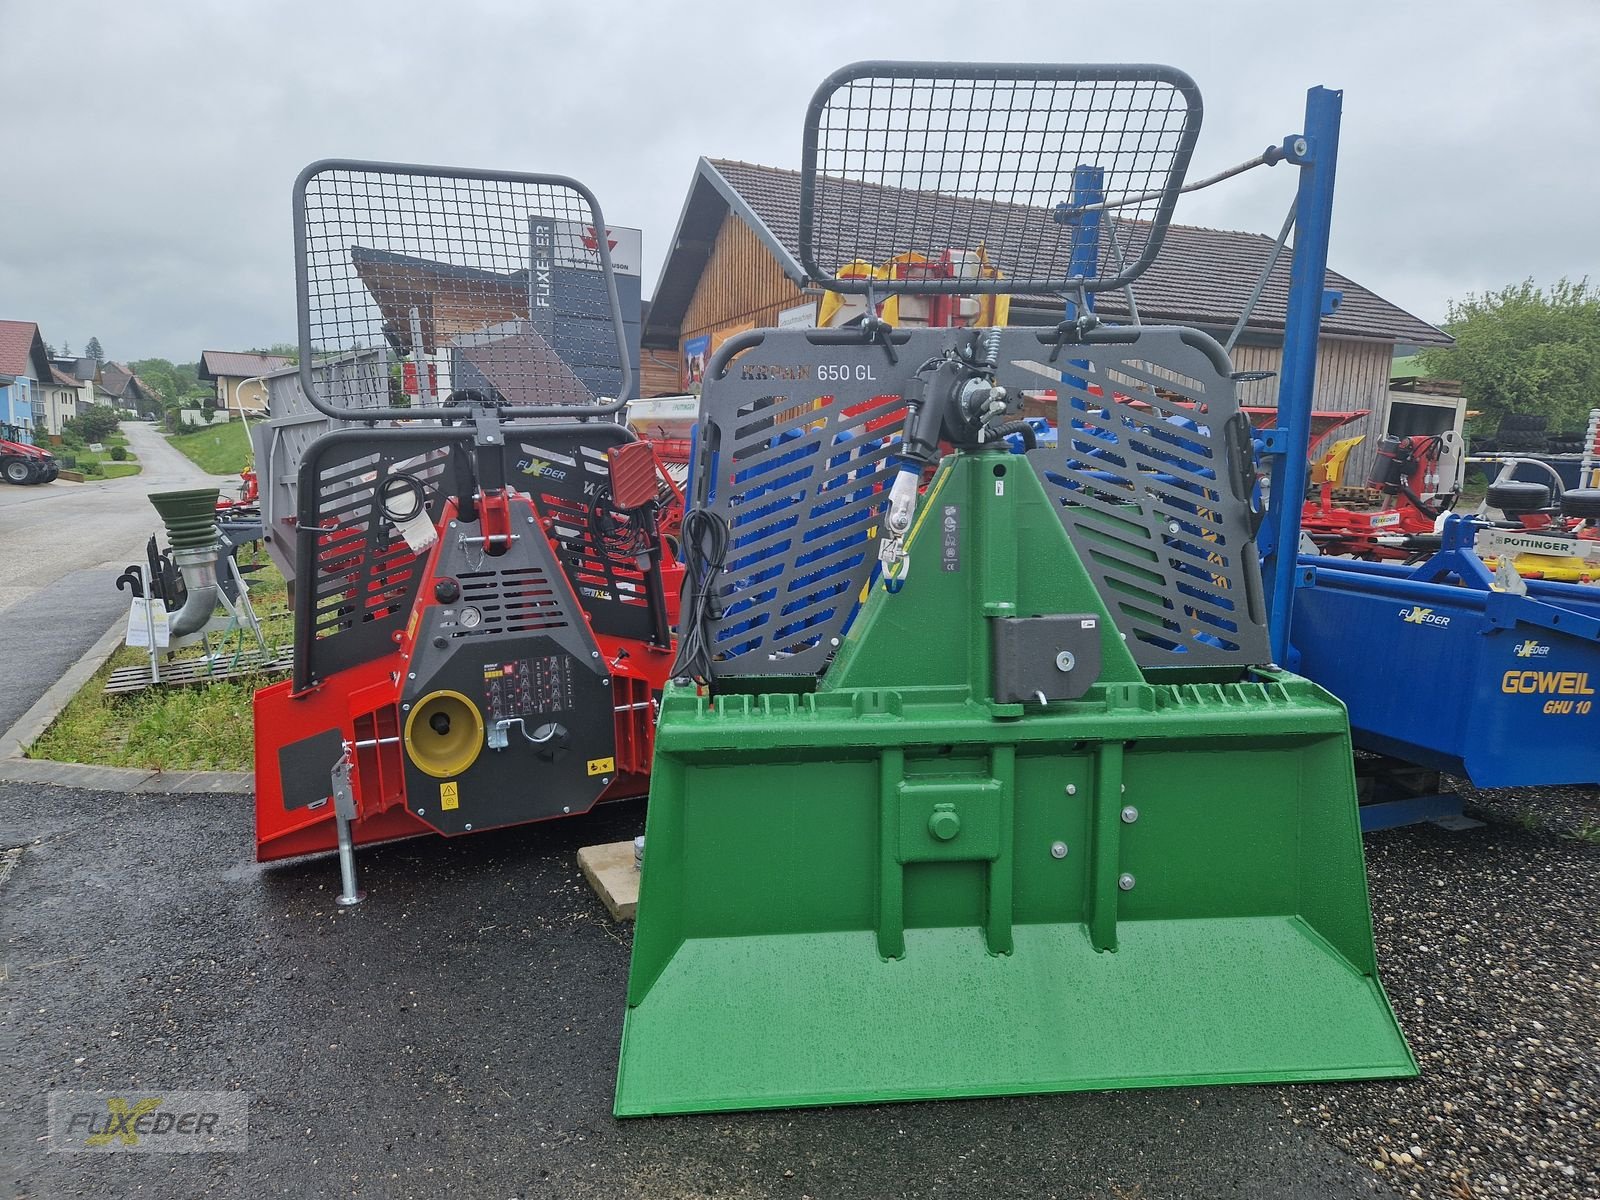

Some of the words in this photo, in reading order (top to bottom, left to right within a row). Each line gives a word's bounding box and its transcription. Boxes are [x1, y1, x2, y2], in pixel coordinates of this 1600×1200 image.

[817, 365, 850, 381] 650
[855, 365, 877, 381] GL
[1543, 700, 1574, 714] GHU
[1575, 701, 1592, 714] 10
